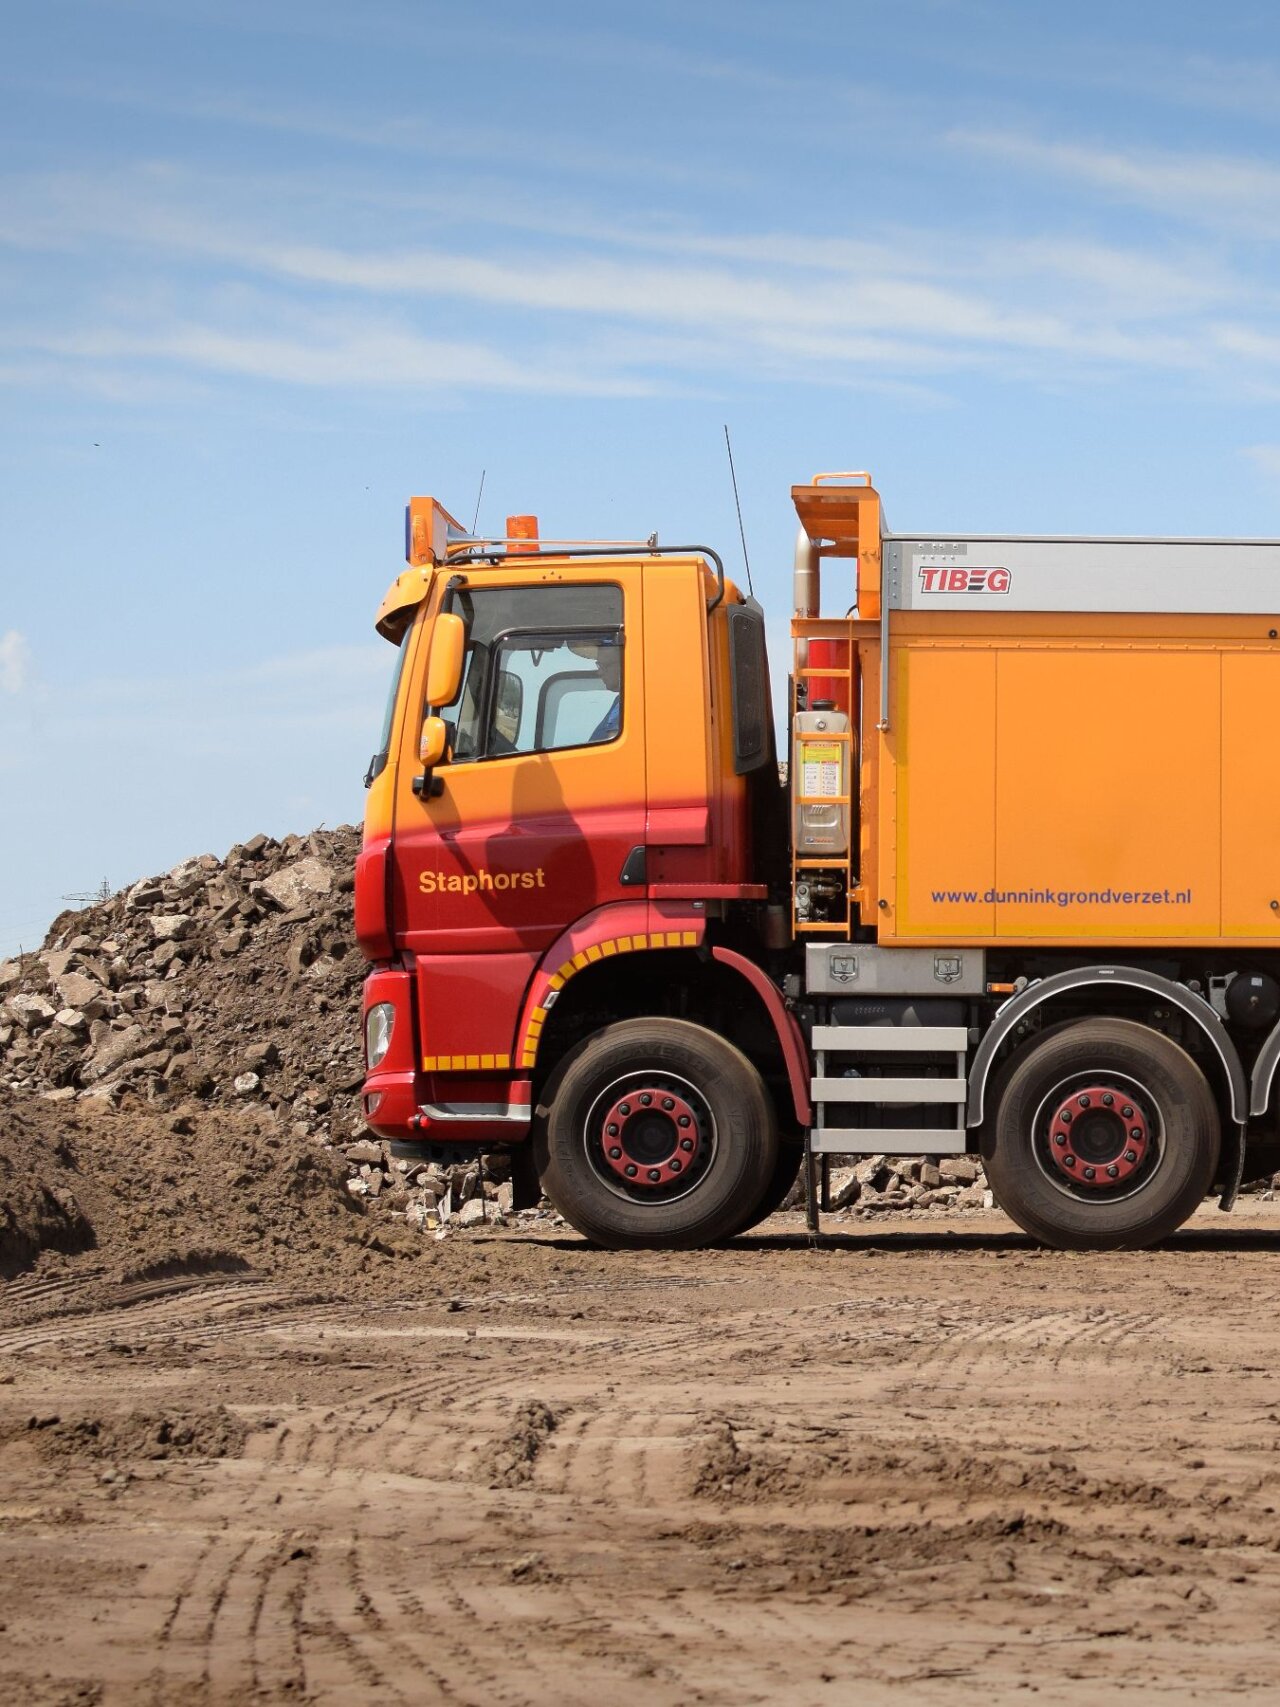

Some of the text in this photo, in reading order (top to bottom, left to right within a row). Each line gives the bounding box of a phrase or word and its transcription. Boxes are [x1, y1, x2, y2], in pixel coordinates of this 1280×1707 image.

[922, 569, 1009, 591] TIBEG
[420, 868, 546, 895] Staphorst
[931, 889, 1192, 906] www.dunninkgrondverzet.nl
